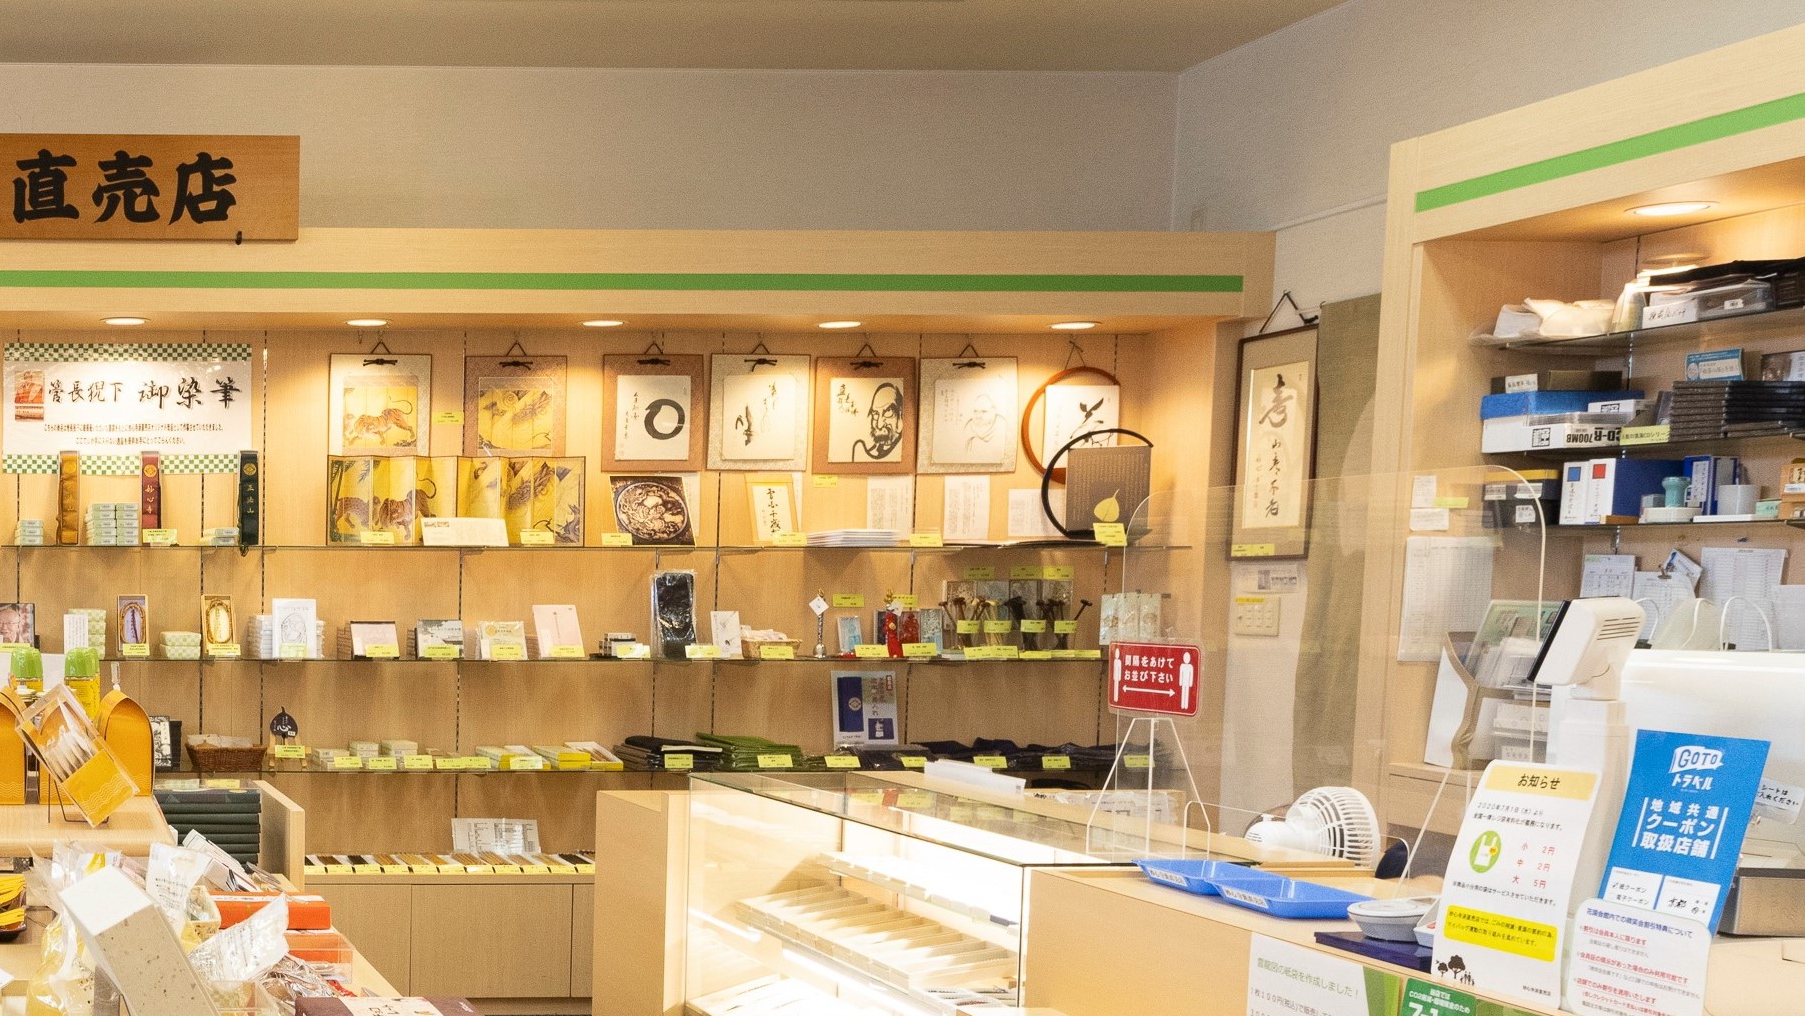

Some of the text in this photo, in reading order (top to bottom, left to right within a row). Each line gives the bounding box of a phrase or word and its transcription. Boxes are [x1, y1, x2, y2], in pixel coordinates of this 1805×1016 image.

[1124, 654, 1175, 669] 間隔をあけて
[1123, 670, 1174, 684] お並び下さい
[1517, 774, 1561, 791] お知らせ
[1671, 774, 1713, 791] トラベル
[1650, 798, 1720, 820] 地域共通
[1646, 812, 1716, 837] クーポン
[1640, 833, 1712, 859] 取扱店舗
[1511, 874, 1520, 885] 大
